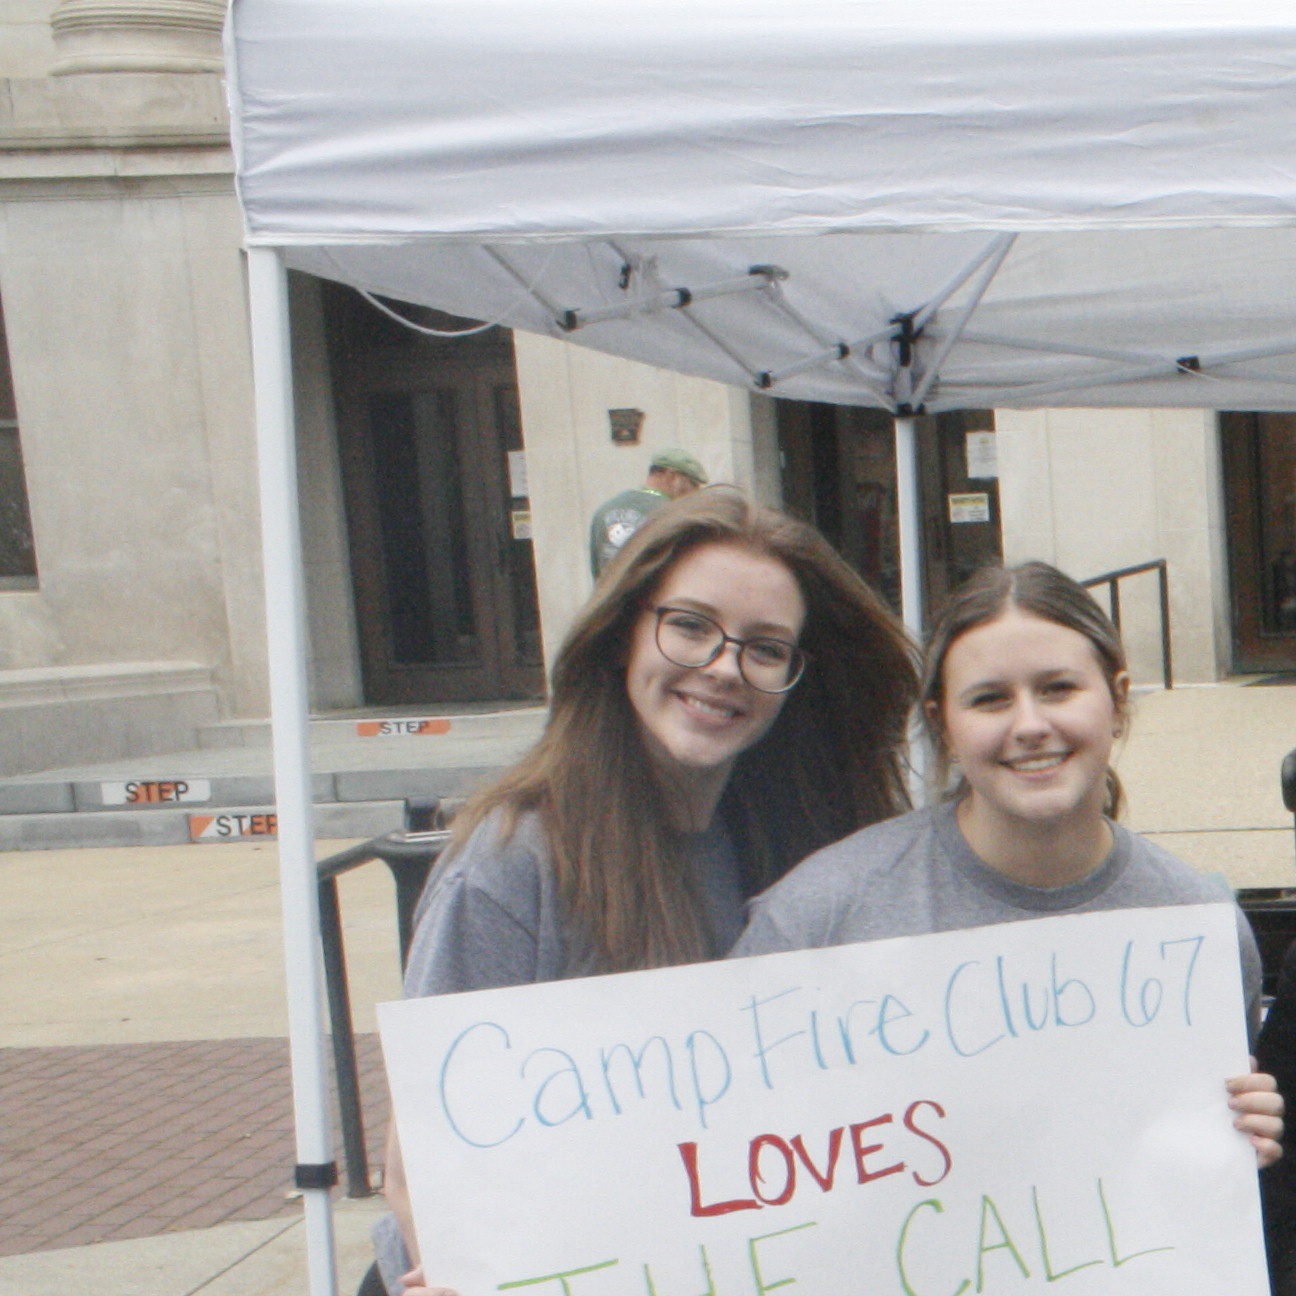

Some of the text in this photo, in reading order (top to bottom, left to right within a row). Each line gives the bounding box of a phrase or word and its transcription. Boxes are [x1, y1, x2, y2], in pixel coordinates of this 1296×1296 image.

[378, 720, 431, 735] STEP
[125, 780, 191, 803] STEP
[439, 934, 1206, 1149] Camp Fire Club 67
[677, 1099, 954, 1217] LOVES
